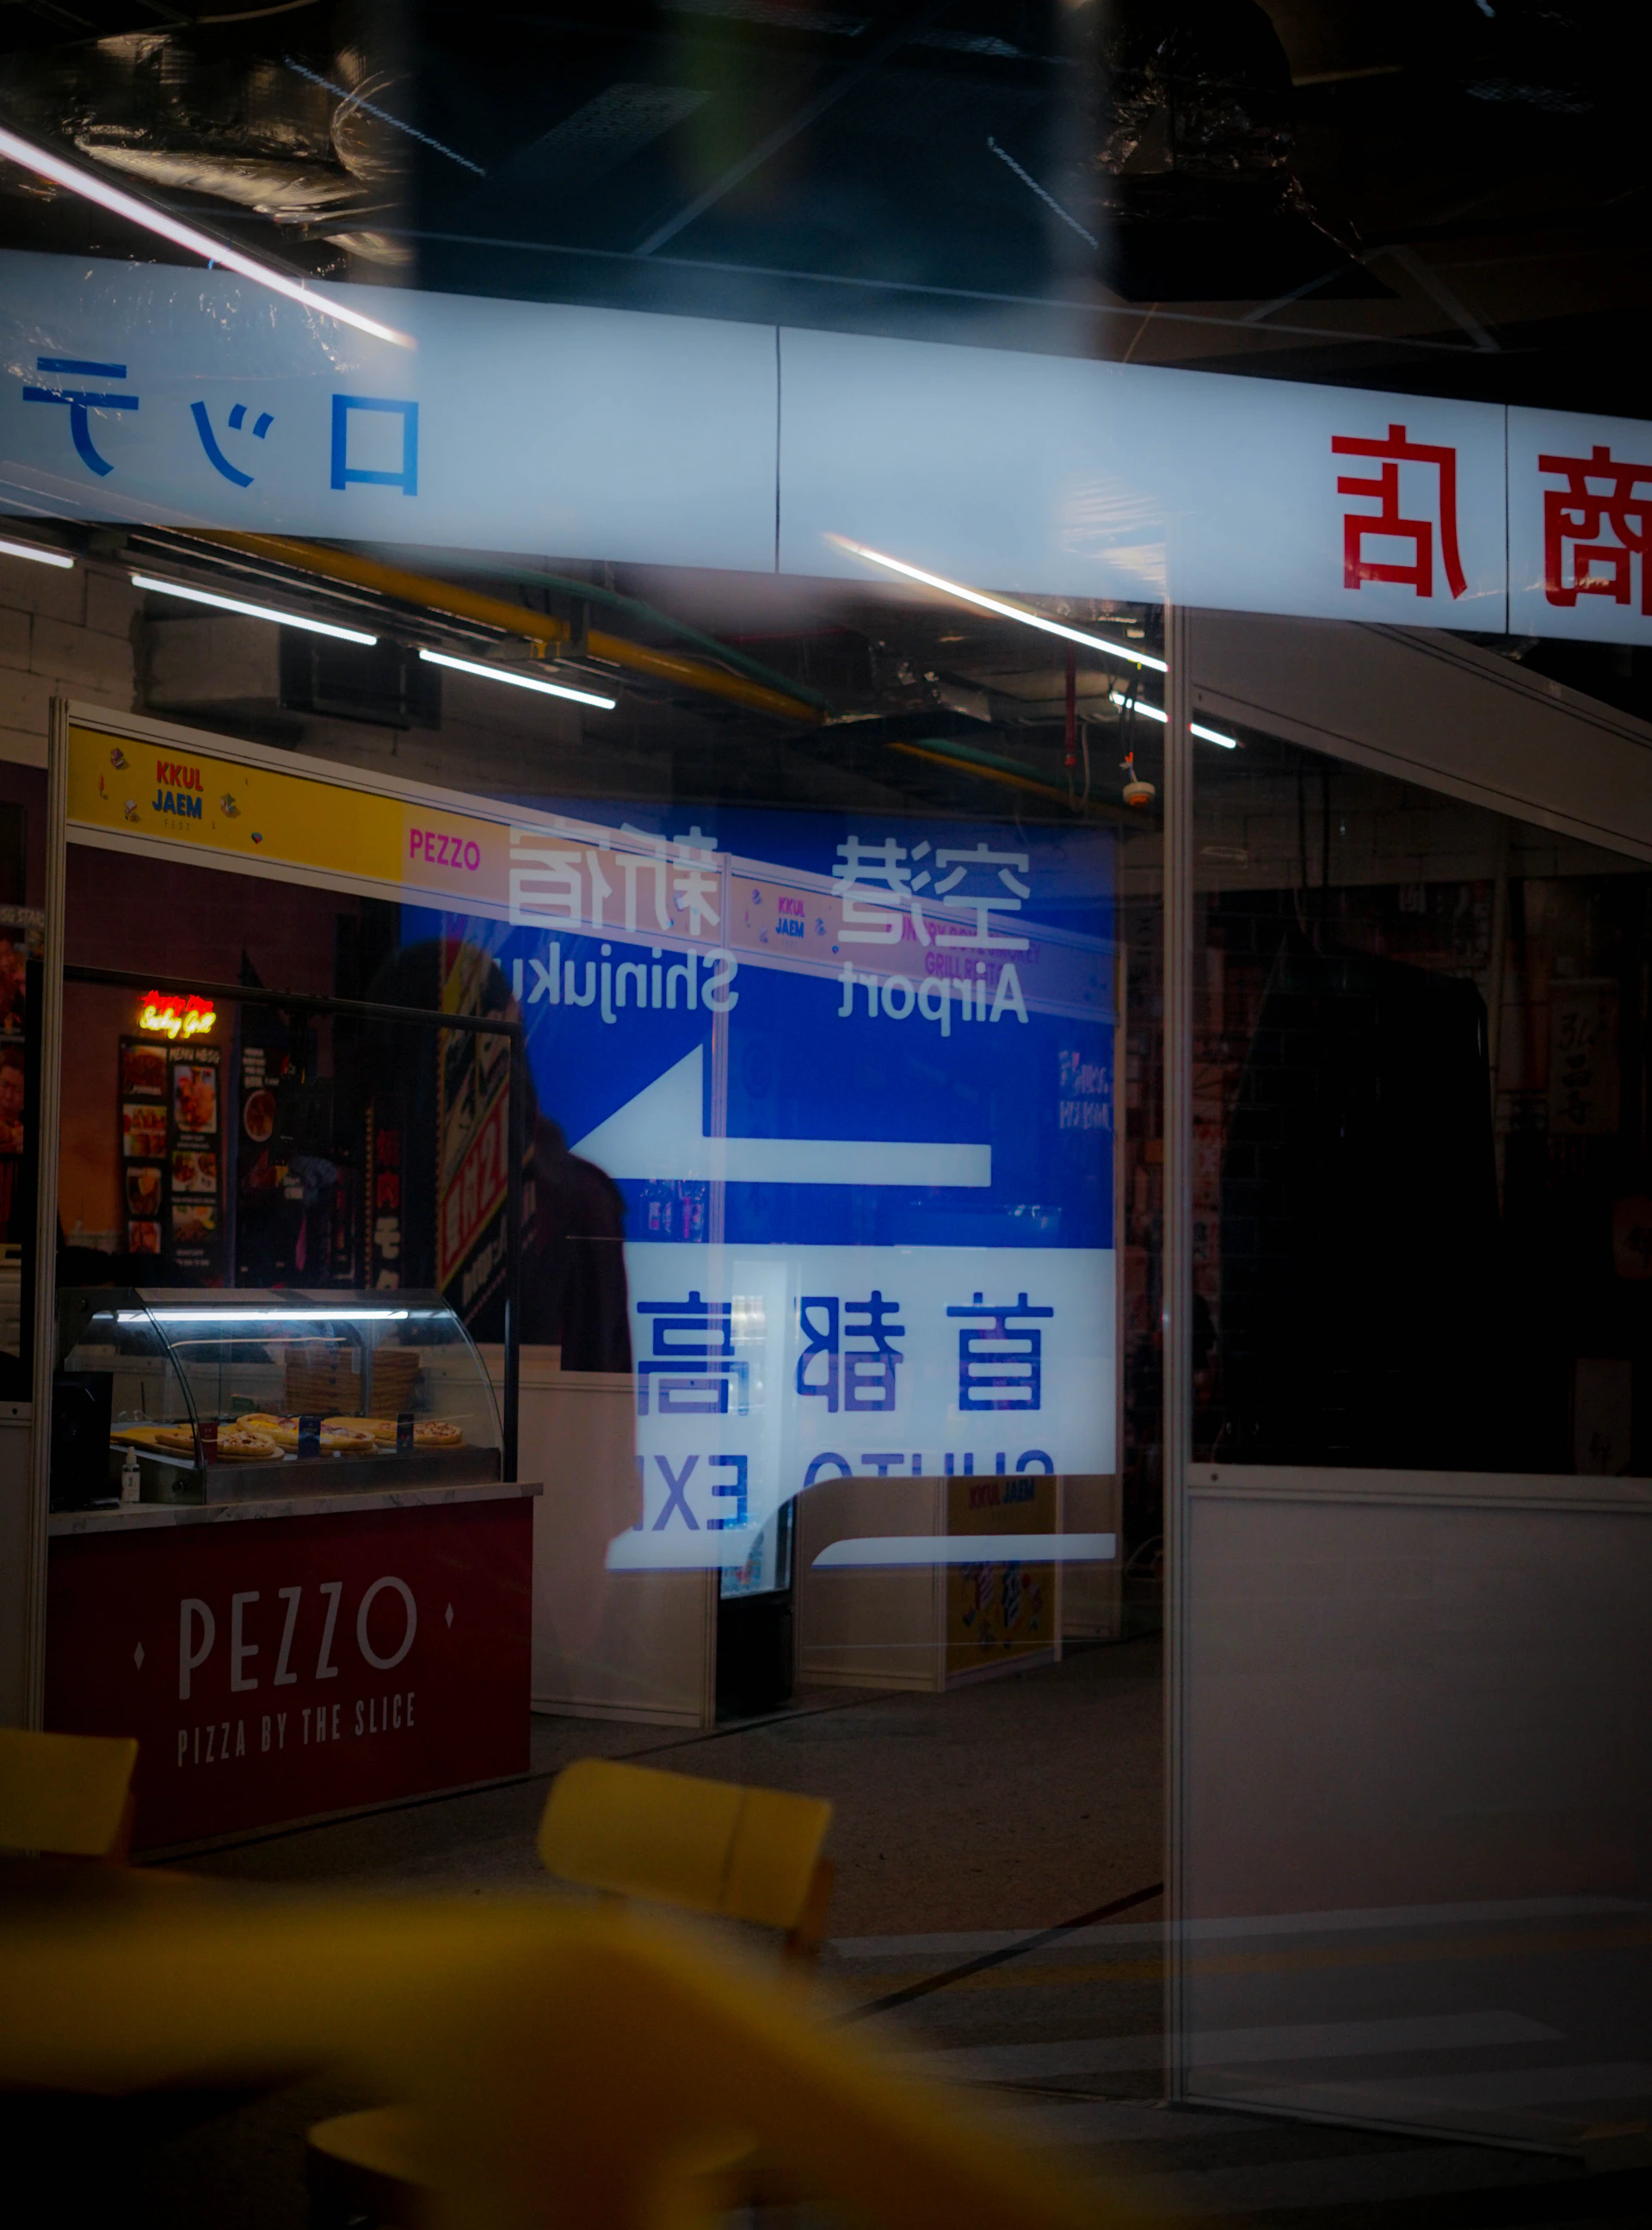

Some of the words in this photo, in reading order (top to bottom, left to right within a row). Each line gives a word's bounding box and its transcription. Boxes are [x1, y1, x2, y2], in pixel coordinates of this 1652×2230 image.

[157, 760, 204, 792] KKUL
[151, 788, 203, 820] JAEM
[164, 818, 191, 831] FEST
[410, 828, 480, 872] PEZZO
[778, 896, 805, 917] KKUL
[775, 917, 804, 939] JAEM
[178, 1575, 418, 1701] PEZZO
[177, 1720, 246, 1768] PIZZA
[261, 1712, 288, 1752] BY
[302, 1703, 341, 1745] THE
[354, 1691, 416, 1737] SLICE
